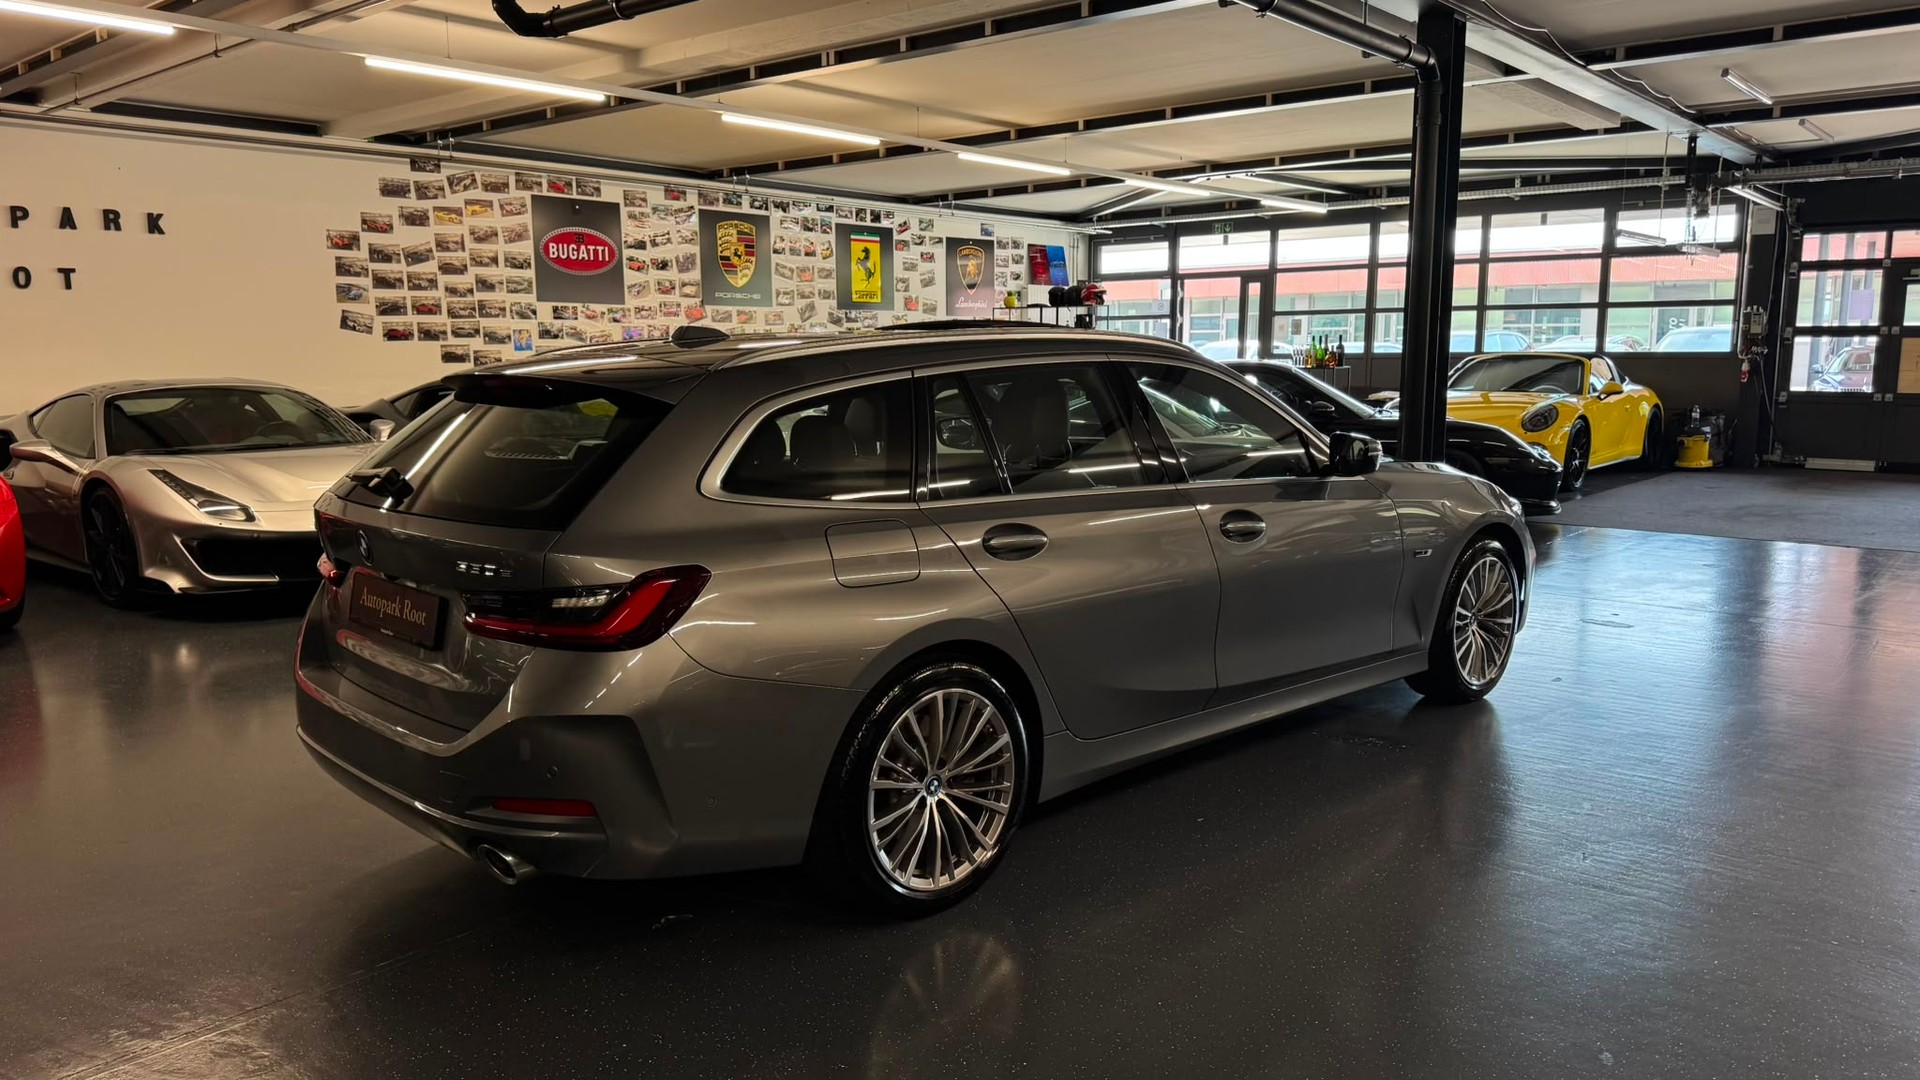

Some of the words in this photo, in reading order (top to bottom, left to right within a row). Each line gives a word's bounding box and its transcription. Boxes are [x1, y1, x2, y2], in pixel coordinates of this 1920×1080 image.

[9, 205, 166, 235] PARK
[548, 242, 610, 262] BUGATTI
[714, 291, 761, 299] PORSCHE
[360, 586, 401, 618] Autopark
[403, 599, 427, 626] Root
